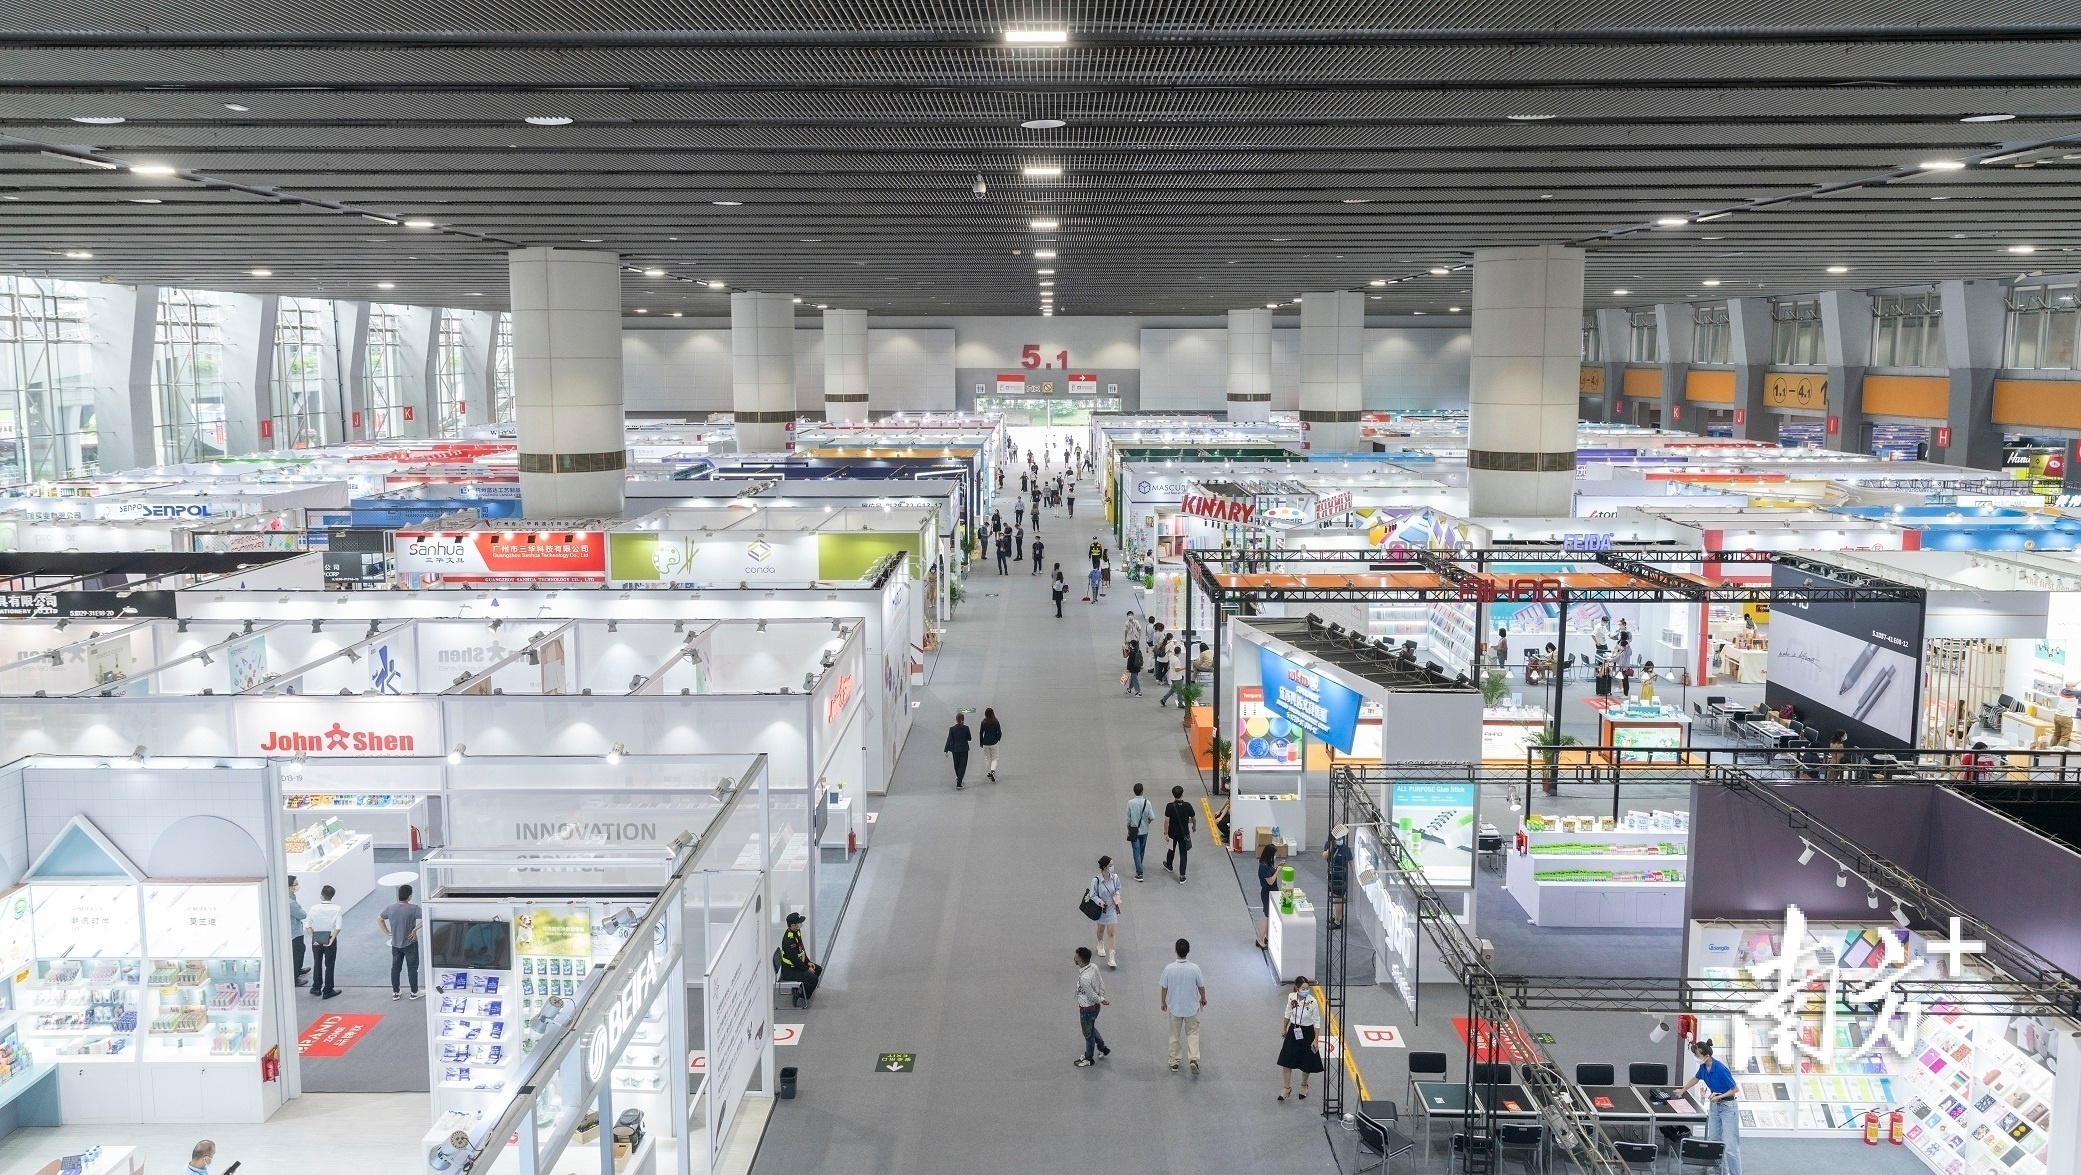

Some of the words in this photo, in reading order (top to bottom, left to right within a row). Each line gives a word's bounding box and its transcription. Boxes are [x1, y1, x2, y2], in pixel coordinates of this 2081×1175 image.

[1021, 344, 1068, 370] 5.1
[1940, 432, 1948, 444] H
[143, 505, 212, 517] SENPOL
[1181, 494, 1256, 524] KINARY
[410, 542, 464, 556] Sanhua
[1564, 533, 1612, 552] FEIDA
[744, 571, 776, 580] conda
[261, 731, 323, 751] John
[353, 731, 414, 751] Shen
[1397, 785, 1408, 793] ALL
[1409, 786, 1435, 794] PURPOSE
[1451, 786, 1465, 794] Stick
[516, 822, 657, 841] INNOVATION
[608, 949, 658, 1056] BEIFA
